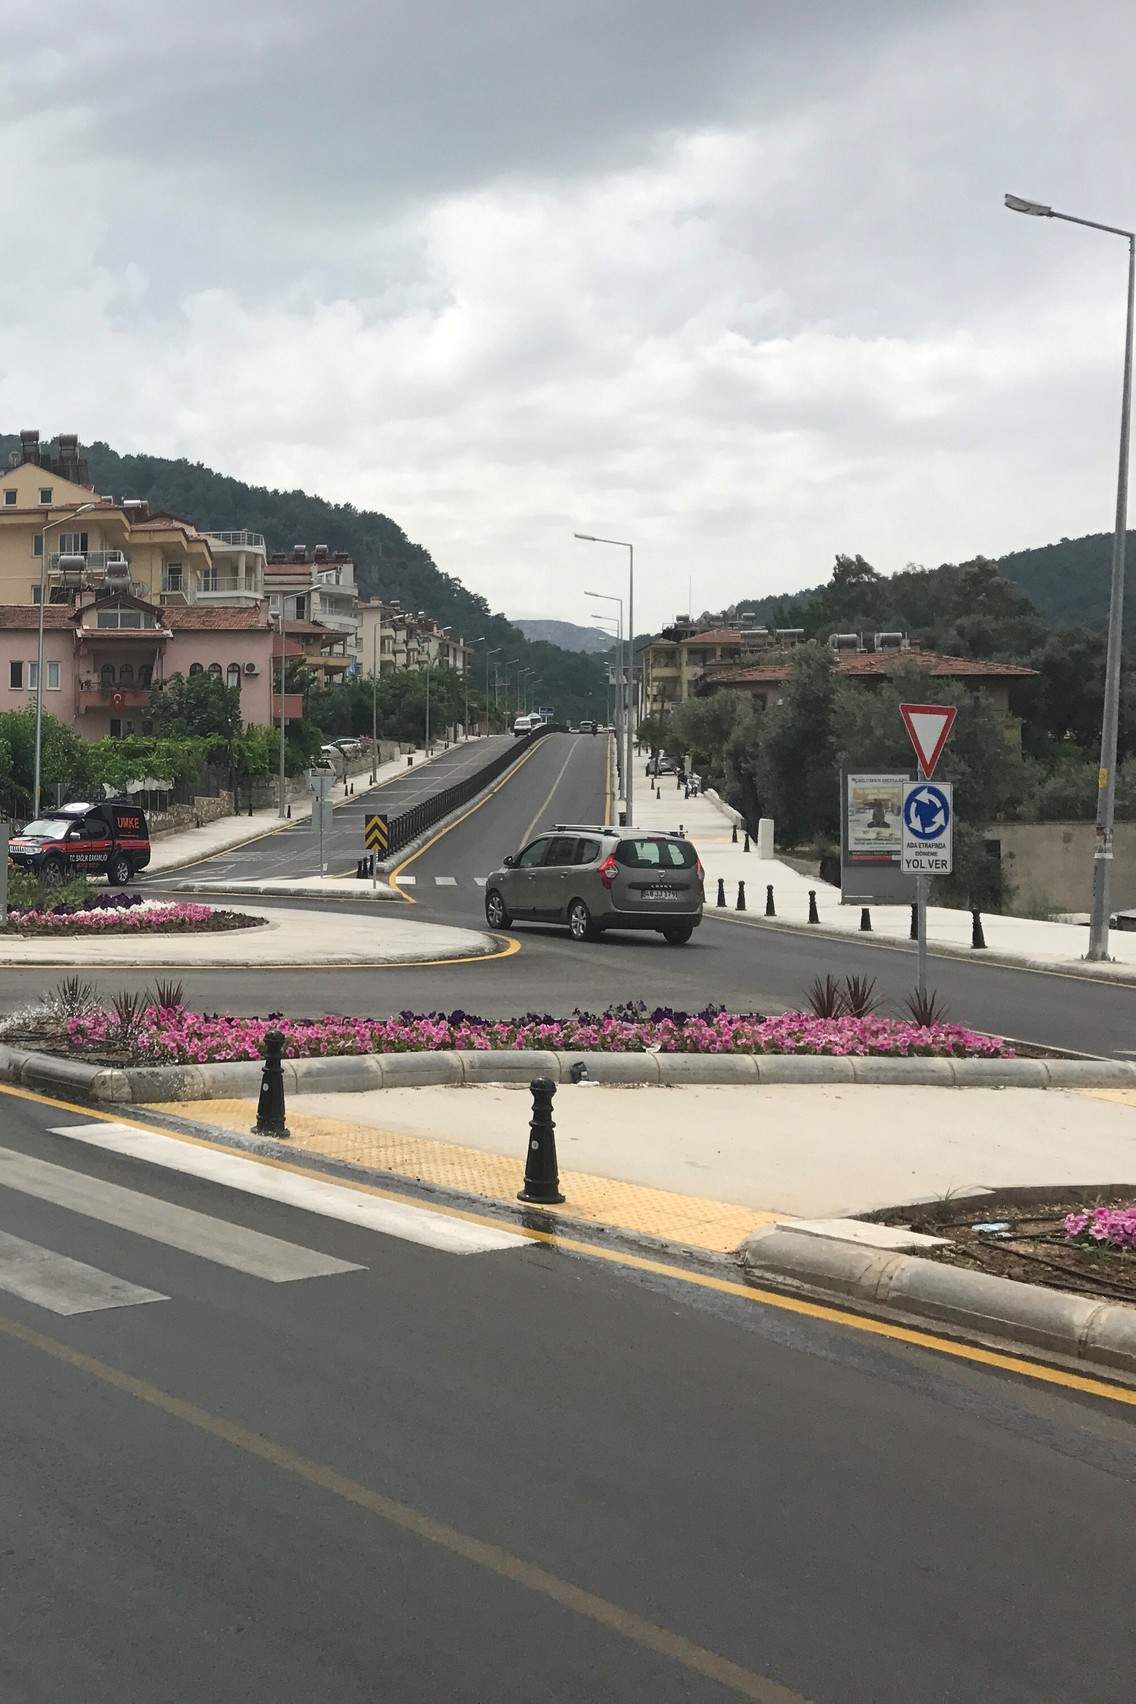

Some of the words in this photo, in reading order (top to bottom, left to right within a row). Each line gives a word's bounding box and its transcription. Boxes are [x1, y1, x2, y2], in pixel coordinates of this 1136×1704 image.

[117, 817, 139, 828] UMKE
[905, 858, 925, 869] YOL
[928, 858, 948, 870] VER
